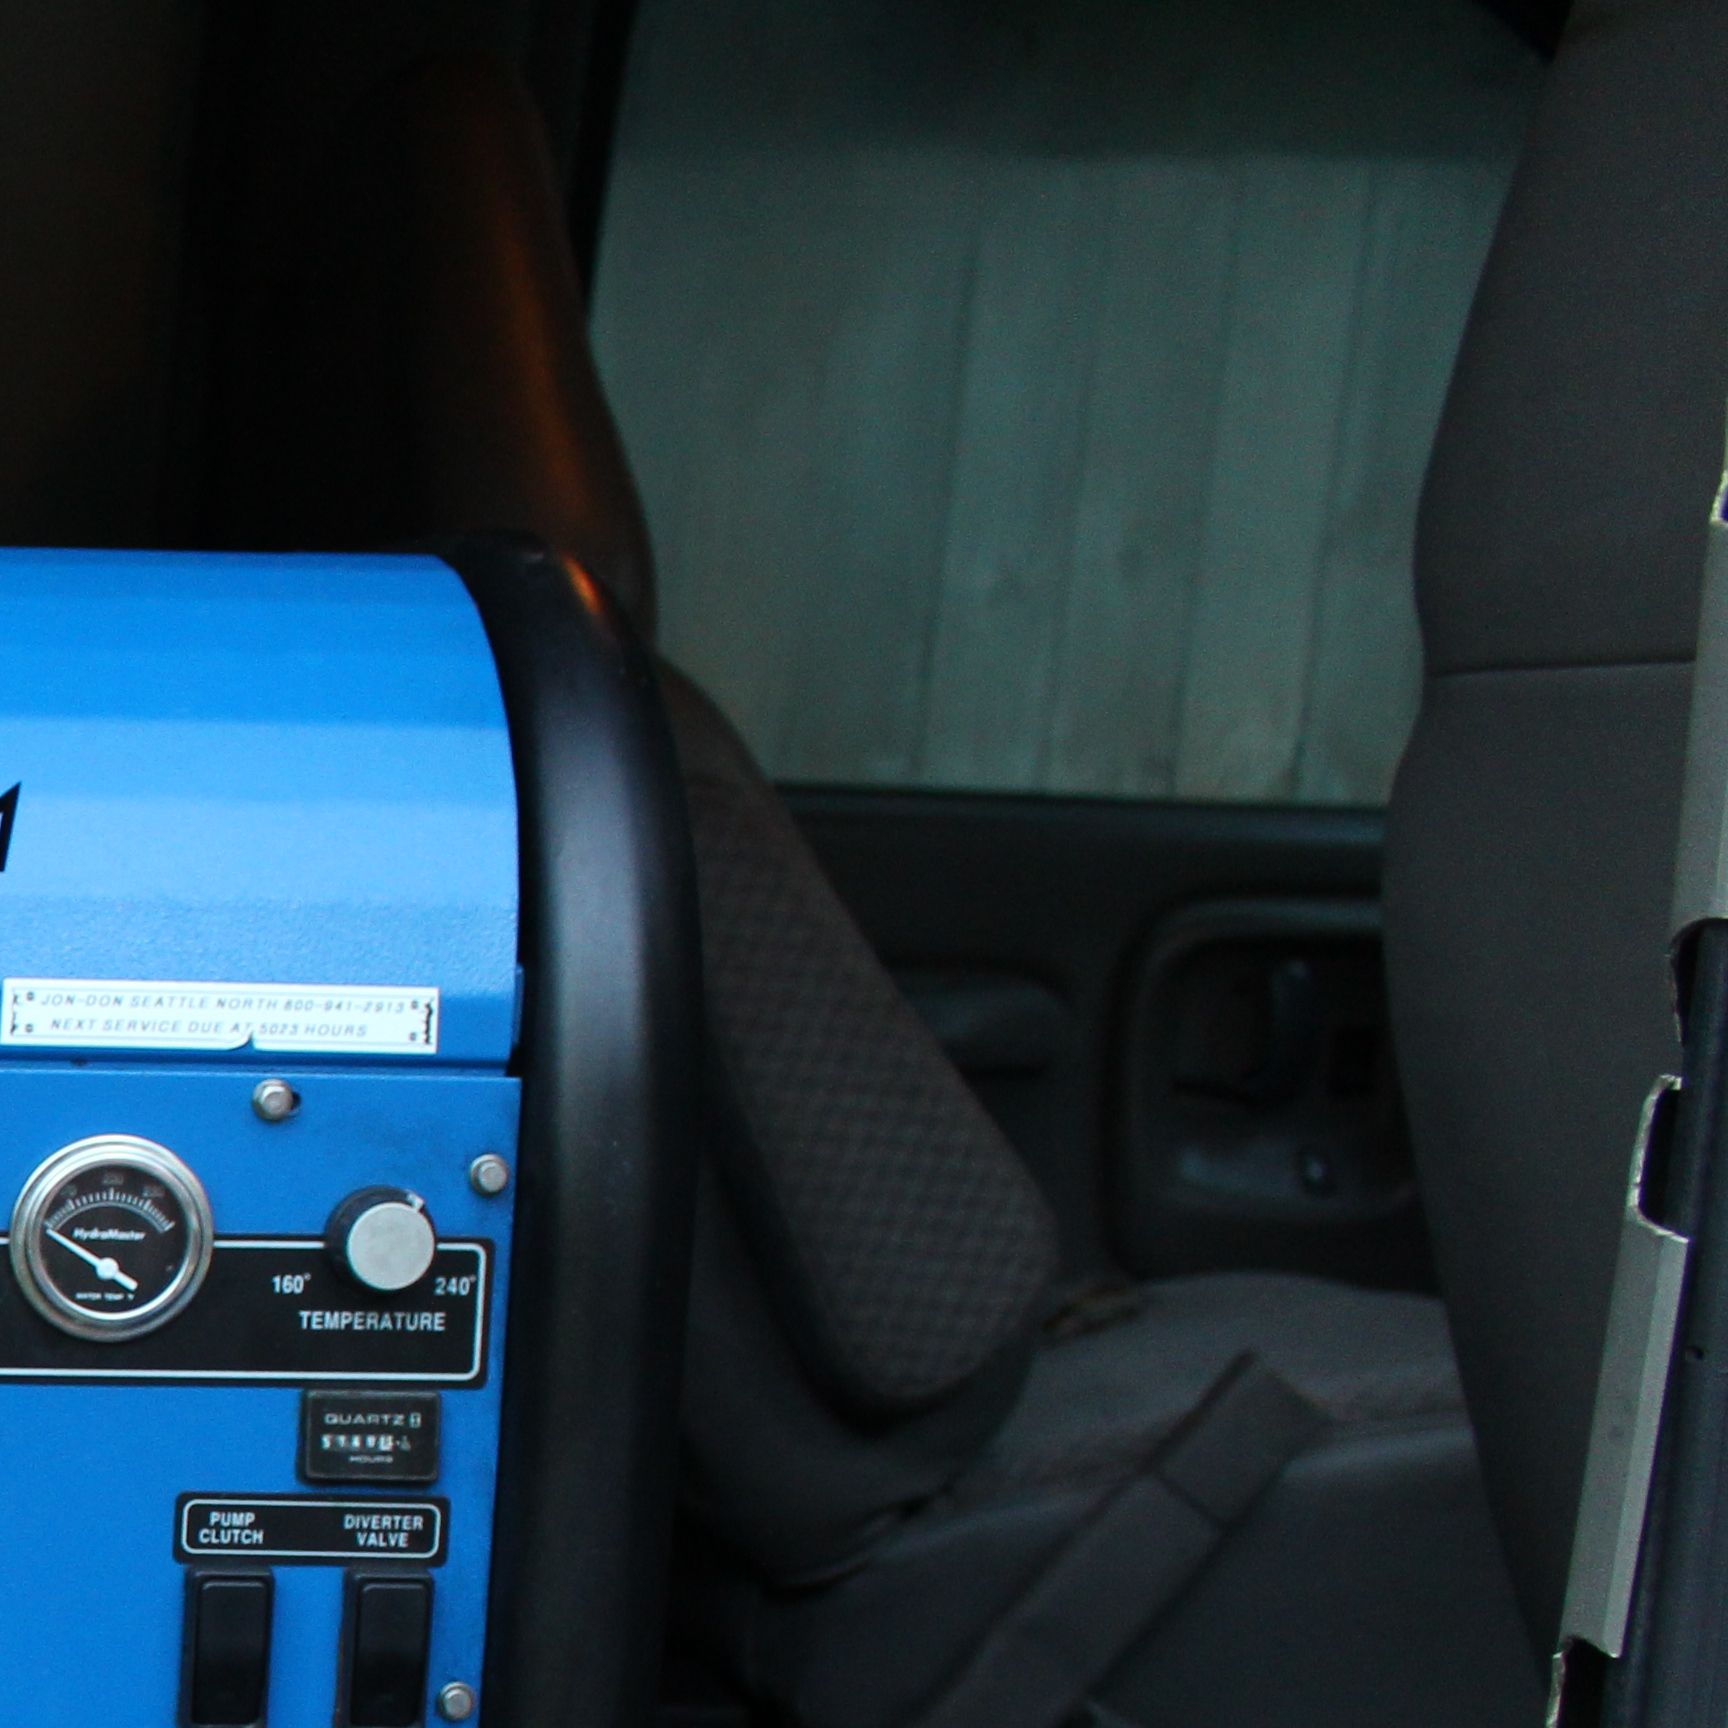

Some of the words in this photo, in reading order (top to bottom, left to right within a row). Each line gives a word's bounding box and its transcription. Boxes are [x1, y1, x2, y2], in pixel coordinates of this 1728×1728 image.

[41, 994, 122, 1008] JON-DON
[131, 995, 209, 1010] SEATTLE
[217, 998, 278, 1011] NORTH
[51, 1018, 96, 1031] NEXT
[103, 1019, 182, 1033] SERVICE
[188, 1021, 223, 1034] DUE
[304, 1023, 367, 1037] HOURS
[299, 1310, 446, 1331] TEMPERATURE
[324, 1413, 405, 1426] QUARTZ
[209, 1511, 255, 1527] PUMP
[344, 1514, 423, 1530] DIVERTER
[199, 1529, 264, 1544] CLUTCH
[356, 1532, 409, 1548] VALVE
